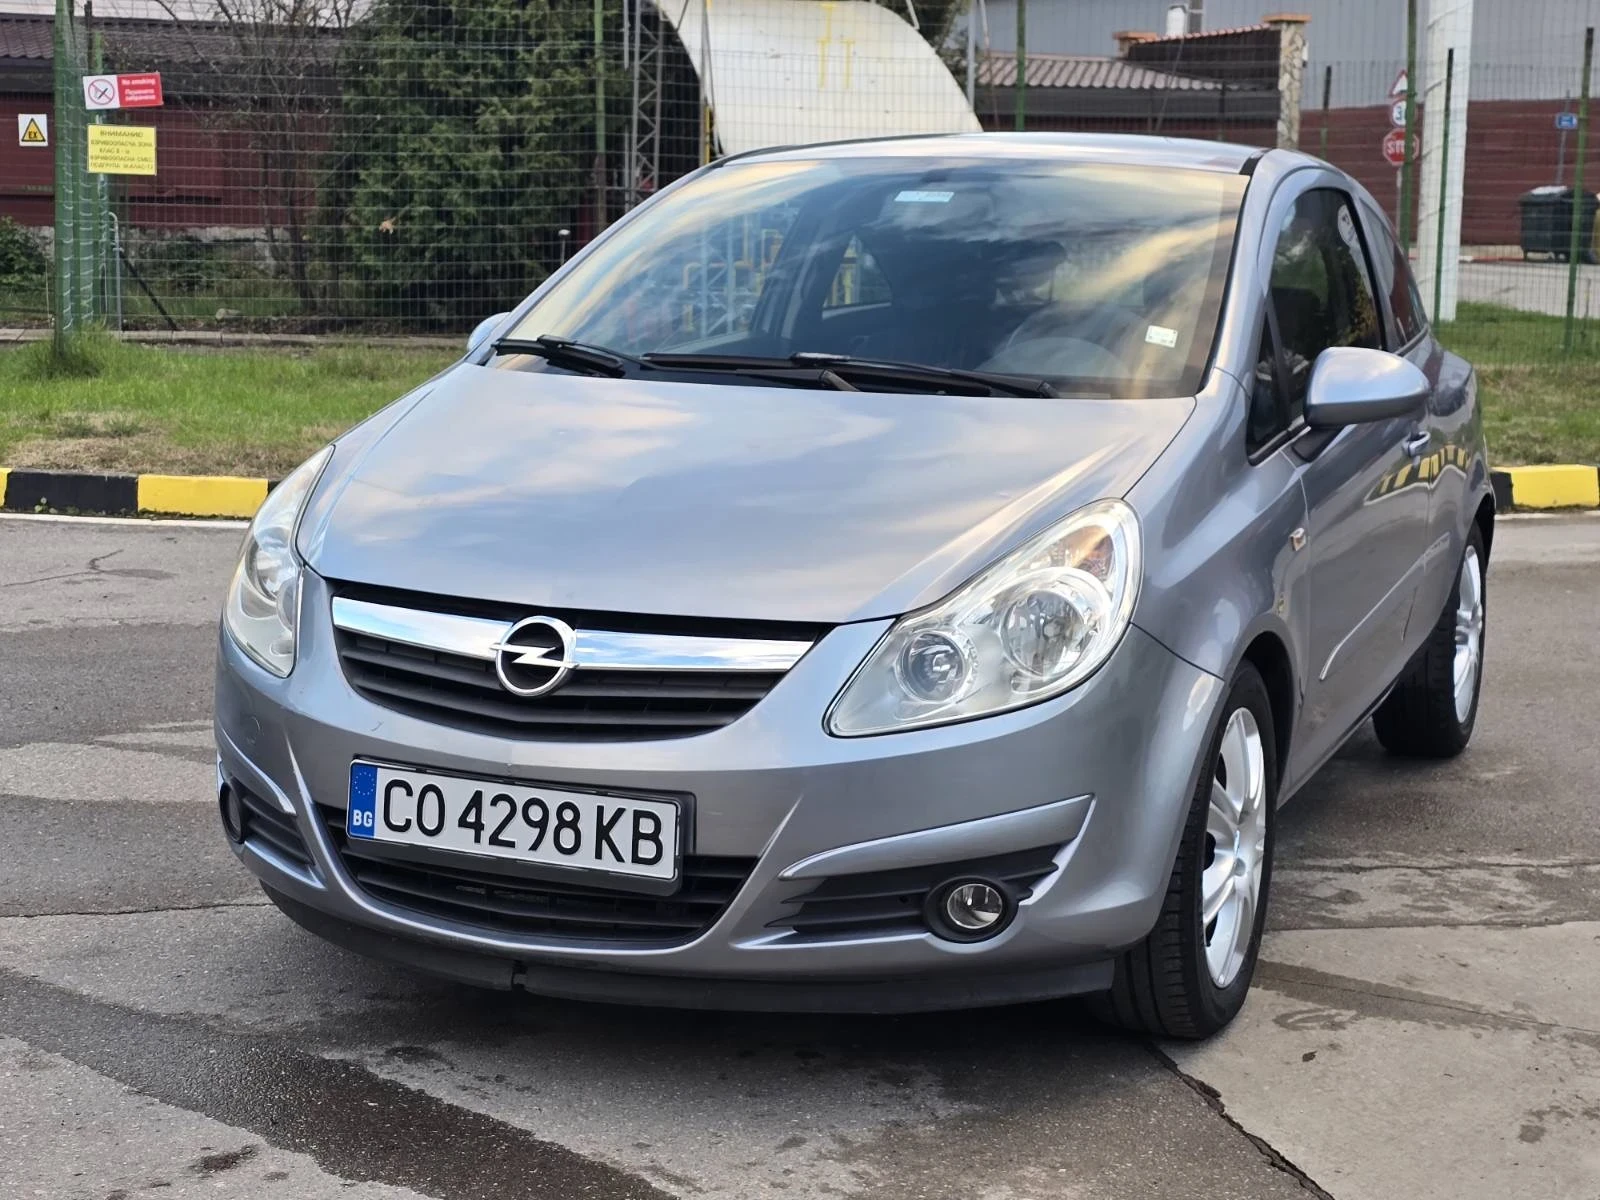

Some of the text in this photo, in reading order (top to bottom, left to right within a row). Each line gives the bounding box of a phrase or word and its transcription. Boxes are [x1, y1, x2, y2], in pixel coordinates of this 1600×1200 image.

[28, 131, 38, 139] EX
[353, 809, 373, 828] BG
[457, 789, 582, 856] 4298
[594, 804, 664, 866] KB
